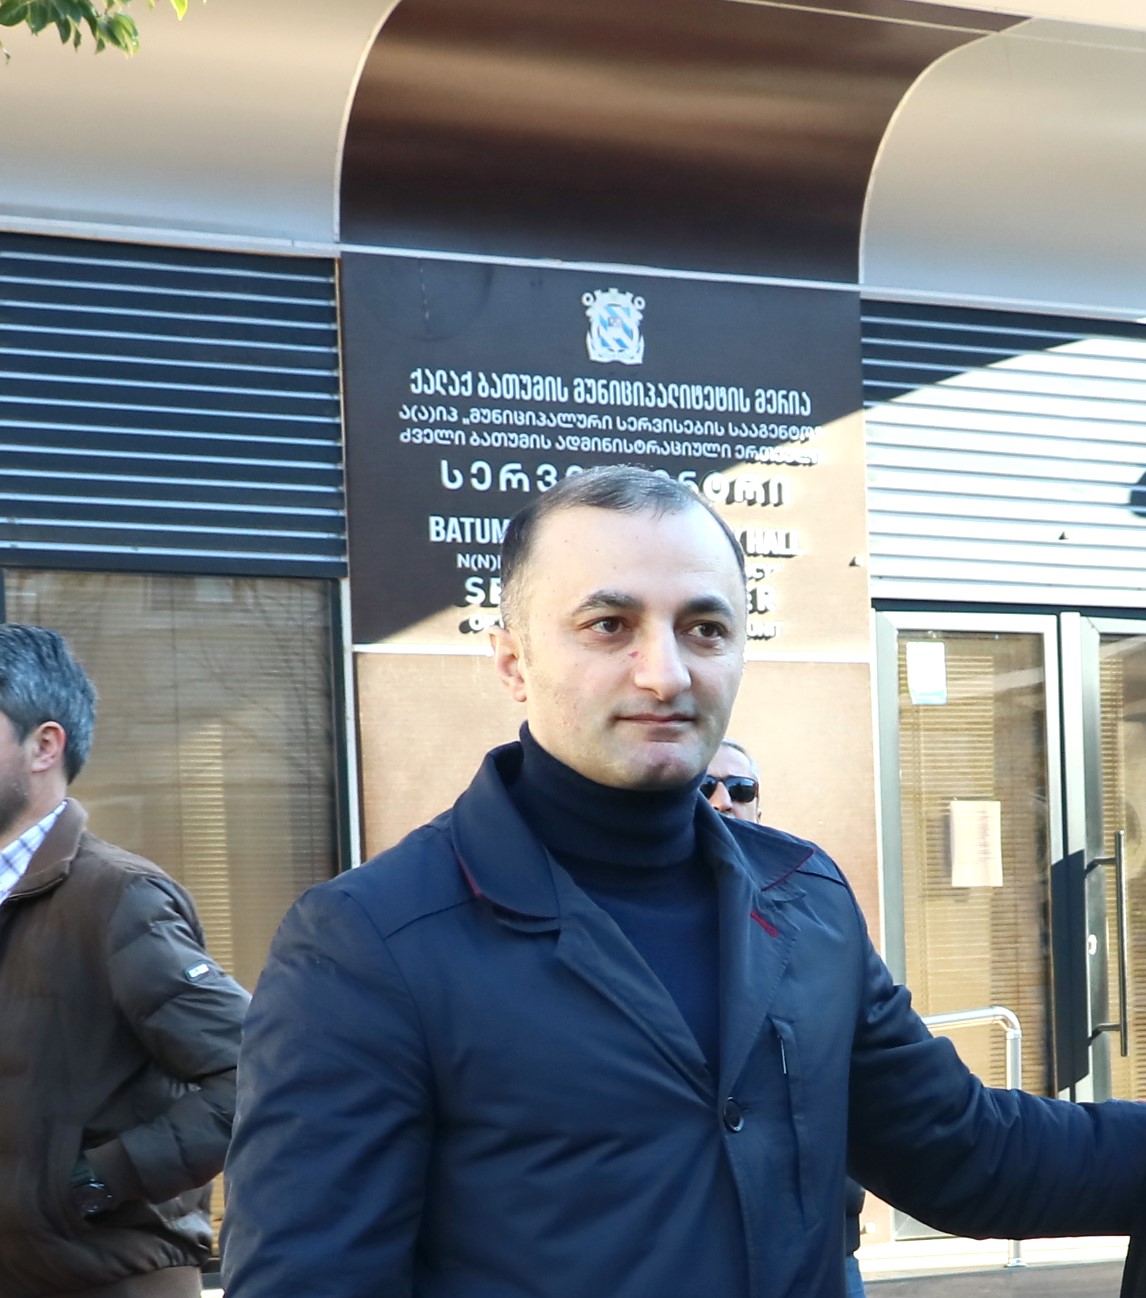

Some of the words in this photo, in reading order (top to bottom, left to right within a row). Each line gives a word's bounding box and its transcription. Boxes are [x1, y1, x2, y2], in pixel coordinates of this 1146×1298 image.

[409, 367, 472, 397] ქალაქ
[477, 371, 569, 402] ბათუმის
[573, 377, 750, 412] მუნიციპალიტეტის
[755, 387, 811, 417] მერია
[616, 415, 725, 437] სერვისების
[399, 427, 466, 446] ძველი
[469, 430, 552, 451] ბათუმის
[555, 434, 732, 459] ადმინისტრაციული
[428, 515, 511, 544] BATUM
